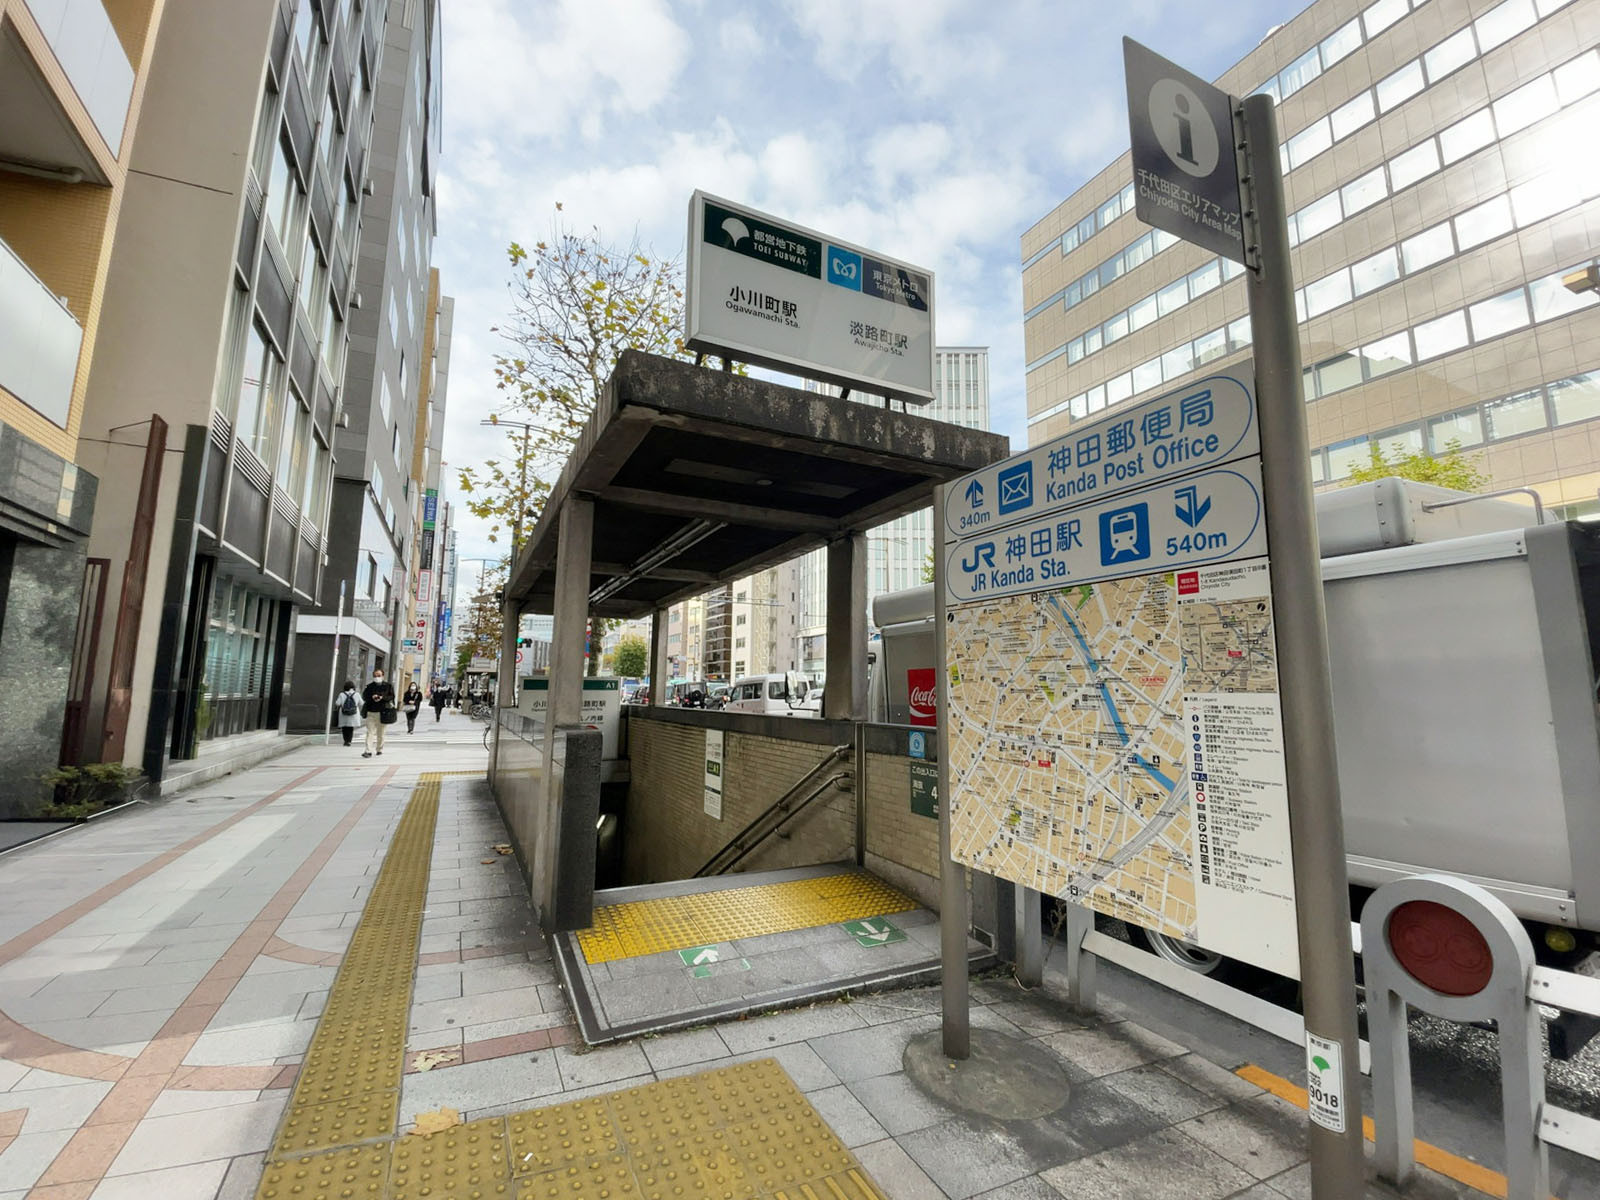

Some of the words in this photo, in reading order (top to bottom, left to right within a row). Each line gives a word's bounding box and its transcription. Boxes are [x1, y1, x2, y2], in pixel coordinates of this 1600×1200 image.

[1137, 168, 1240, 224] 千代田区エリアマップ
[1139, 184, 1179, 211] Chiyoda
[1181, 203, 1200, 223] City
[1202, 212, 1222, 230] Area
[1223, 222, 1242, 240] Map
[753, 230, 807, 257] 都営地下鉄
[753, 243, 771, 254] TOEI
[774, 249, 808, 266] SUBWAY
[873, 269, 919, 292] 東京メトロ
[875, 282, 898, 296] Tokyo
[897, 287, 916, 300] Metro
[725, 300, 783, 324] Ogawamachi
[784, 317, 800, 328] Sta.
[729, 285, 797, 319] 小川町駅
[849, 320, 908, 350] 淡路町駅
[854, 338, 889, 353] Awajicho
[890, 346, 904, 357] Sta.
[1047, 389, 1214, 478] 神田郵便局
[1046, 471, 1097, 502] Kanda
[1103, 452, 1144, 484] Post
[1152, 433, 1220, 469] Office
[959, 512, 991, 530] 340m
[962, 542, 996, 573] JR
[1005, 519, 1082, 563] 神田駅
[1166, 530, 1228, 556] 540m
[971, 573, 986, 593] JR
[990, 566, 1034, 590] Kanda
[1040, 559, 1071, 583] Sta.
[1310, 1084, 1338, 1108] 9018
